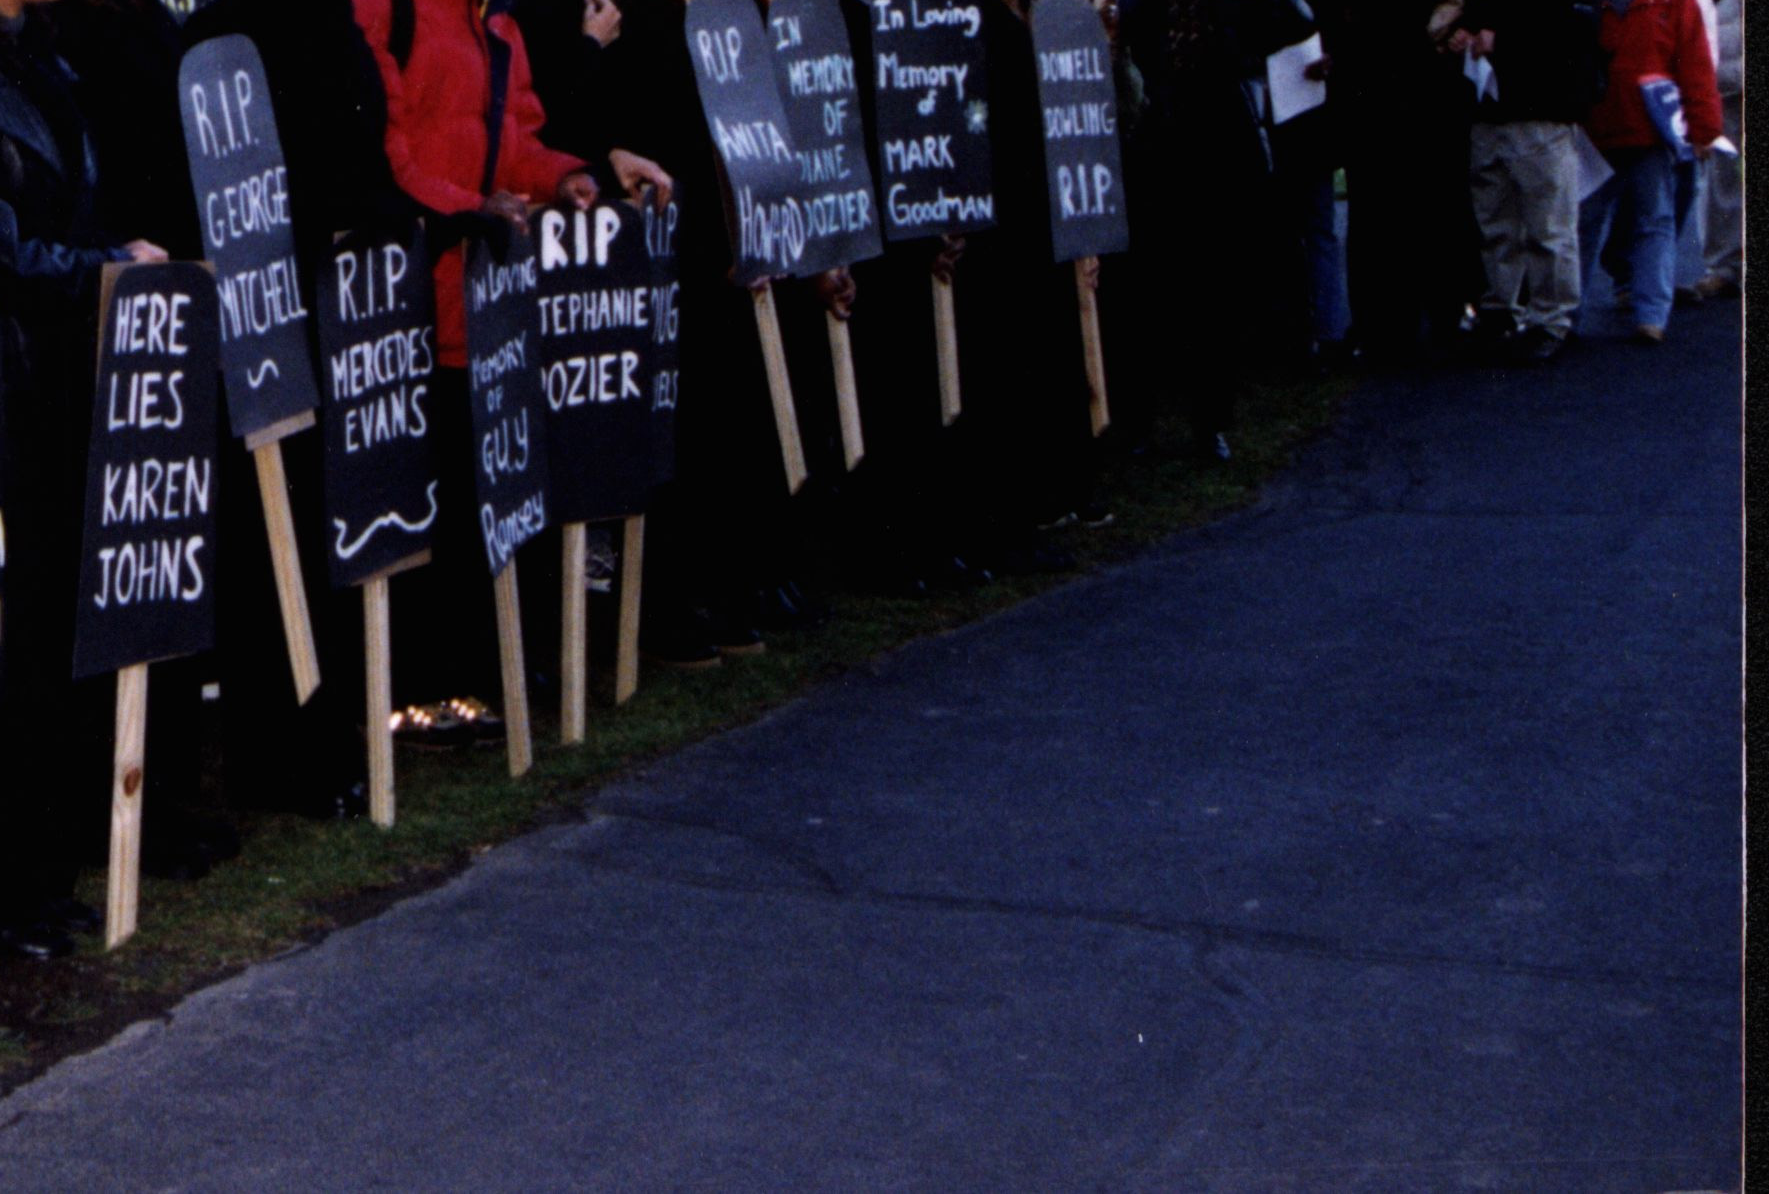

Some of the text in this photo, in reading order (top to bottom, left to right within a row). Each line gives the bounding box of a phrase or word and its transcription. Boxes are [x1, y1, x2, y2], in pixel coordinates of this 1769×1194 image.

[772, 18, 802, 50] IN
[788, 54, 855, 95] MEMORY
[878, 52, 968, 101] Memory
[918, 89, 936, 115] of
[191, 70, 260, 159] R.I.P.
[713, 117, 792, 163] ANITA
[823, 100, 847, 137] OF
[885, 135, 954, 173] MARK
[207, 166, 291, 249] GEORGE
[1058, 164, 1115, 220] R.I.P.
[540, 207, 621, 271] RIP
[738, 185, 805, 268] HOWARD
[216, 256, 307, 342] MITCHELL
[335, 244, 407, 323] R.I.P.
[538, 287, 649, 336] TEPHANIE
[114, 292, 191, 355] HERE
[331, 326, 433, 401] MERCEDES
[471, 331, 527, 391] MEMORY
[542, 352, 640, 411] OZIER
[108, 370, 184, 433] LIES
[345, 384, 427, 453] EVANS
[487, 385, 505, 413] OF
[482, 408, 528, 486] GUY
[102, 456, 210, 526] KAREN
[480, 490, 544, 570] Ramsey
[94, 535, 205, 609] JOHNS
